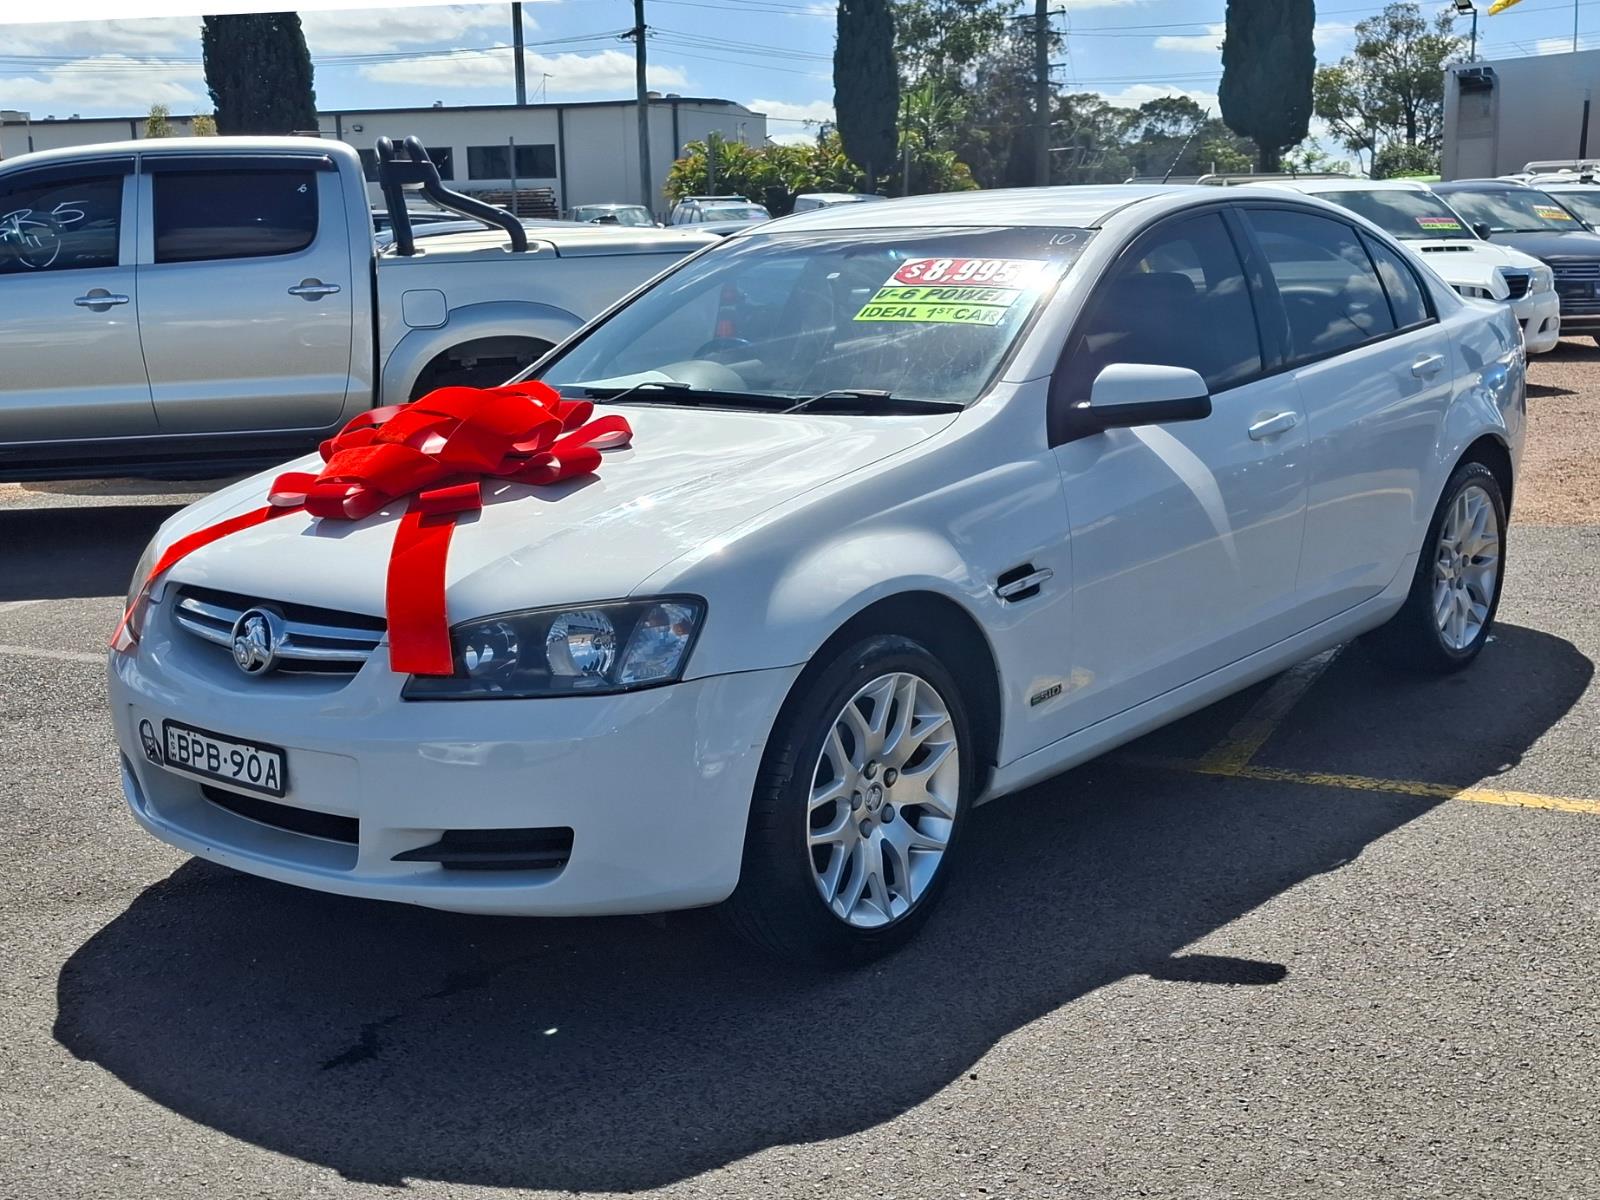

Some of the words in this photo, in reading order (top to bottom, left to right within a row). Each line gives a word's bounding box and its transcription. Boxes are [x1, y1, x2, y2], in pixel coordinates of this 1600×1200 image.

[905, 258, 1021, 283] $8,995
[875, 289, 916, 300] V-6
[859, 307, 917, 318] IDEAL
[927, 307, 953, 318] 1ST
[953, 308, 1000, 322] CAR
